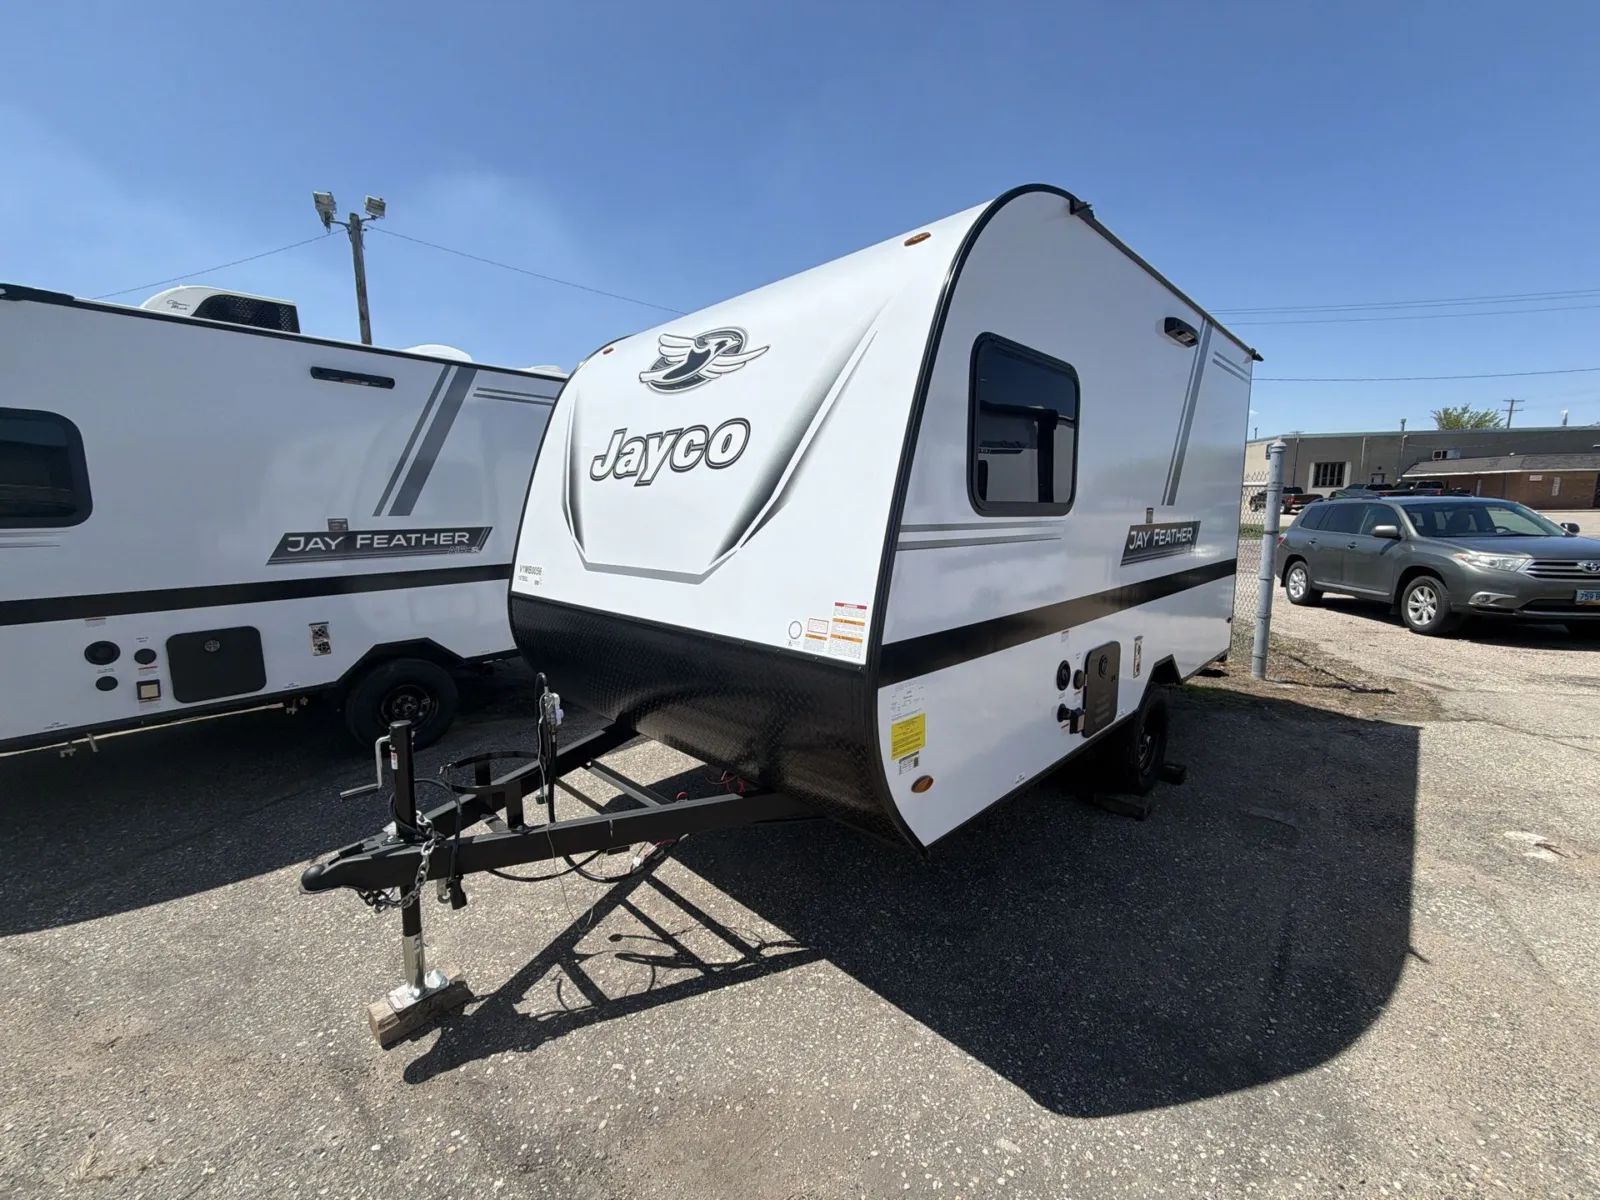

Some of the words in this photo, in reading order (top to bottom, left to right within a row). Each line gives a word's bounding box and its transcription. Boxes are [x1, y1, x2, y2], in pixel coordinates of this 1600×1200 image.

[589, 417, 751, 486] Jayco
[287, 536, 345, 552] JAY
[356, 532, 470, 549] FEATHER
[1129, 531, 1151, 549] JAY
[1153, 527, 1192, 546] FEATHER
